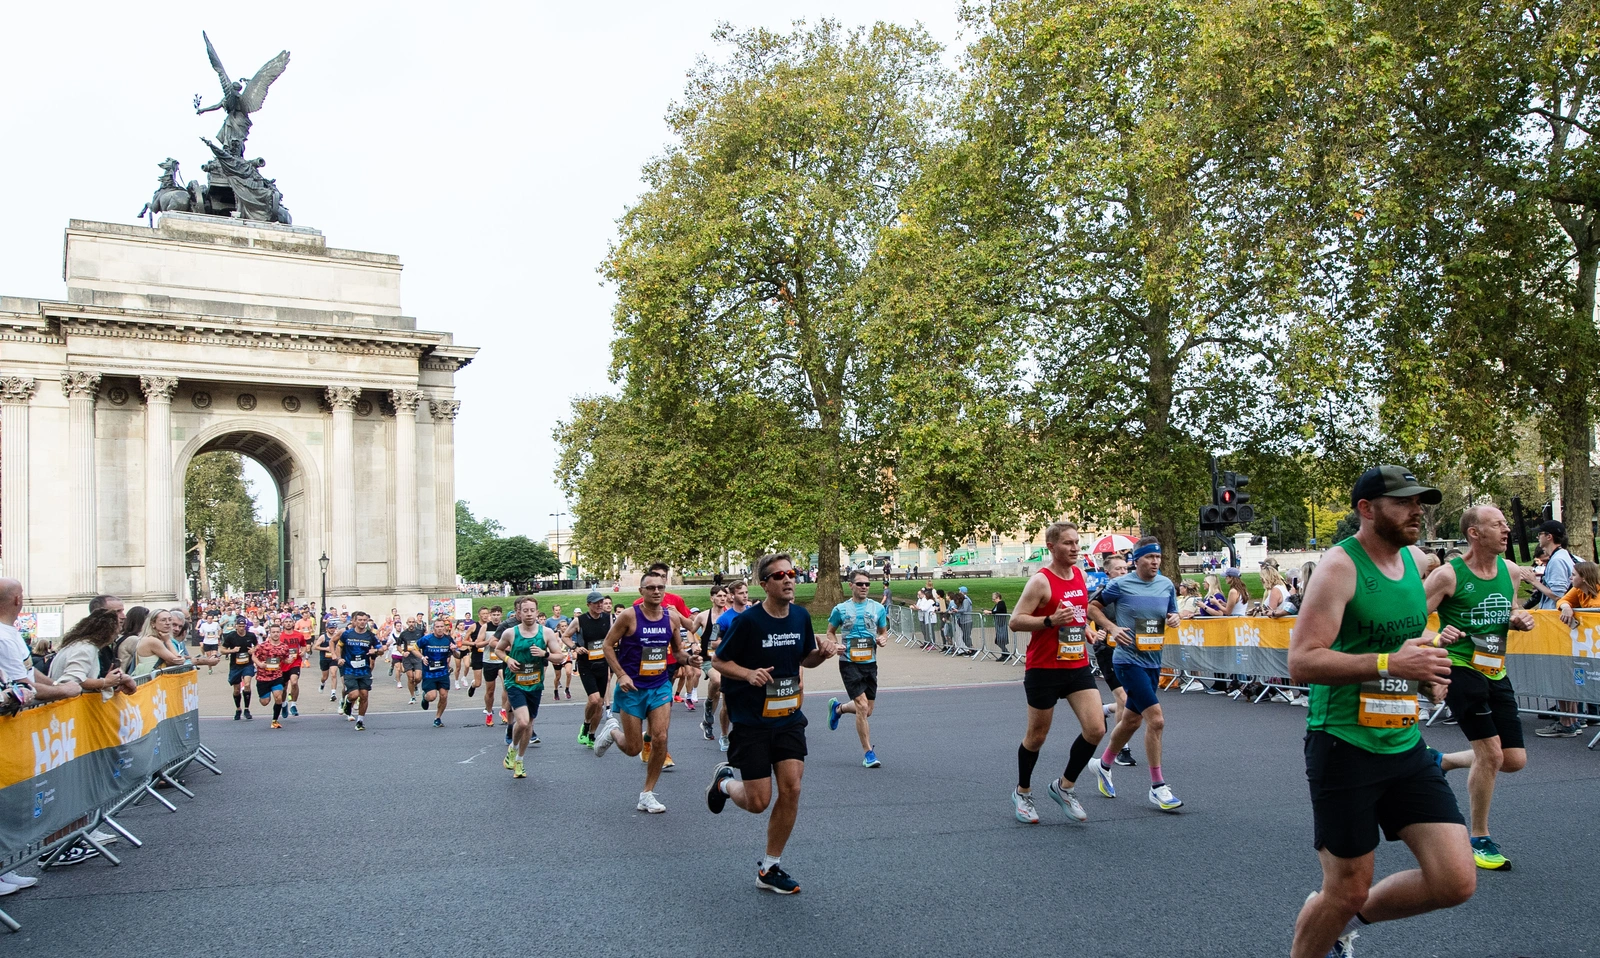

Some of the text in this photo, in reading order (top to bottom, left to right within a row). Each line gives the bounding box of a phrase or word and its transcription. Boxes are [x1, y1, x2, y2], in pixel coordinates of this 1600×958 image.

[1063, 589, 1084, 599] JAKUB
[1484, 610, 1511, 618] ROGUE
[1357, 615, 1422, 635] HARWELL
[1471, 617, 1509, 626] RUNNERS
[773, 632, 801, 641] Canterbury
[1067, 634, 1082, 642] 1323
[1178, 628, 1205, 647] Half
[1234, 627, 1260, 647] Half
[773, 639, 796, 647] Harriers
[1486, 645, 1499, 653] 921
[1379, 678, 1408, 693] 1526
[776, 687, 794, 697] 1836
[31, 717, 77, 777] Half
